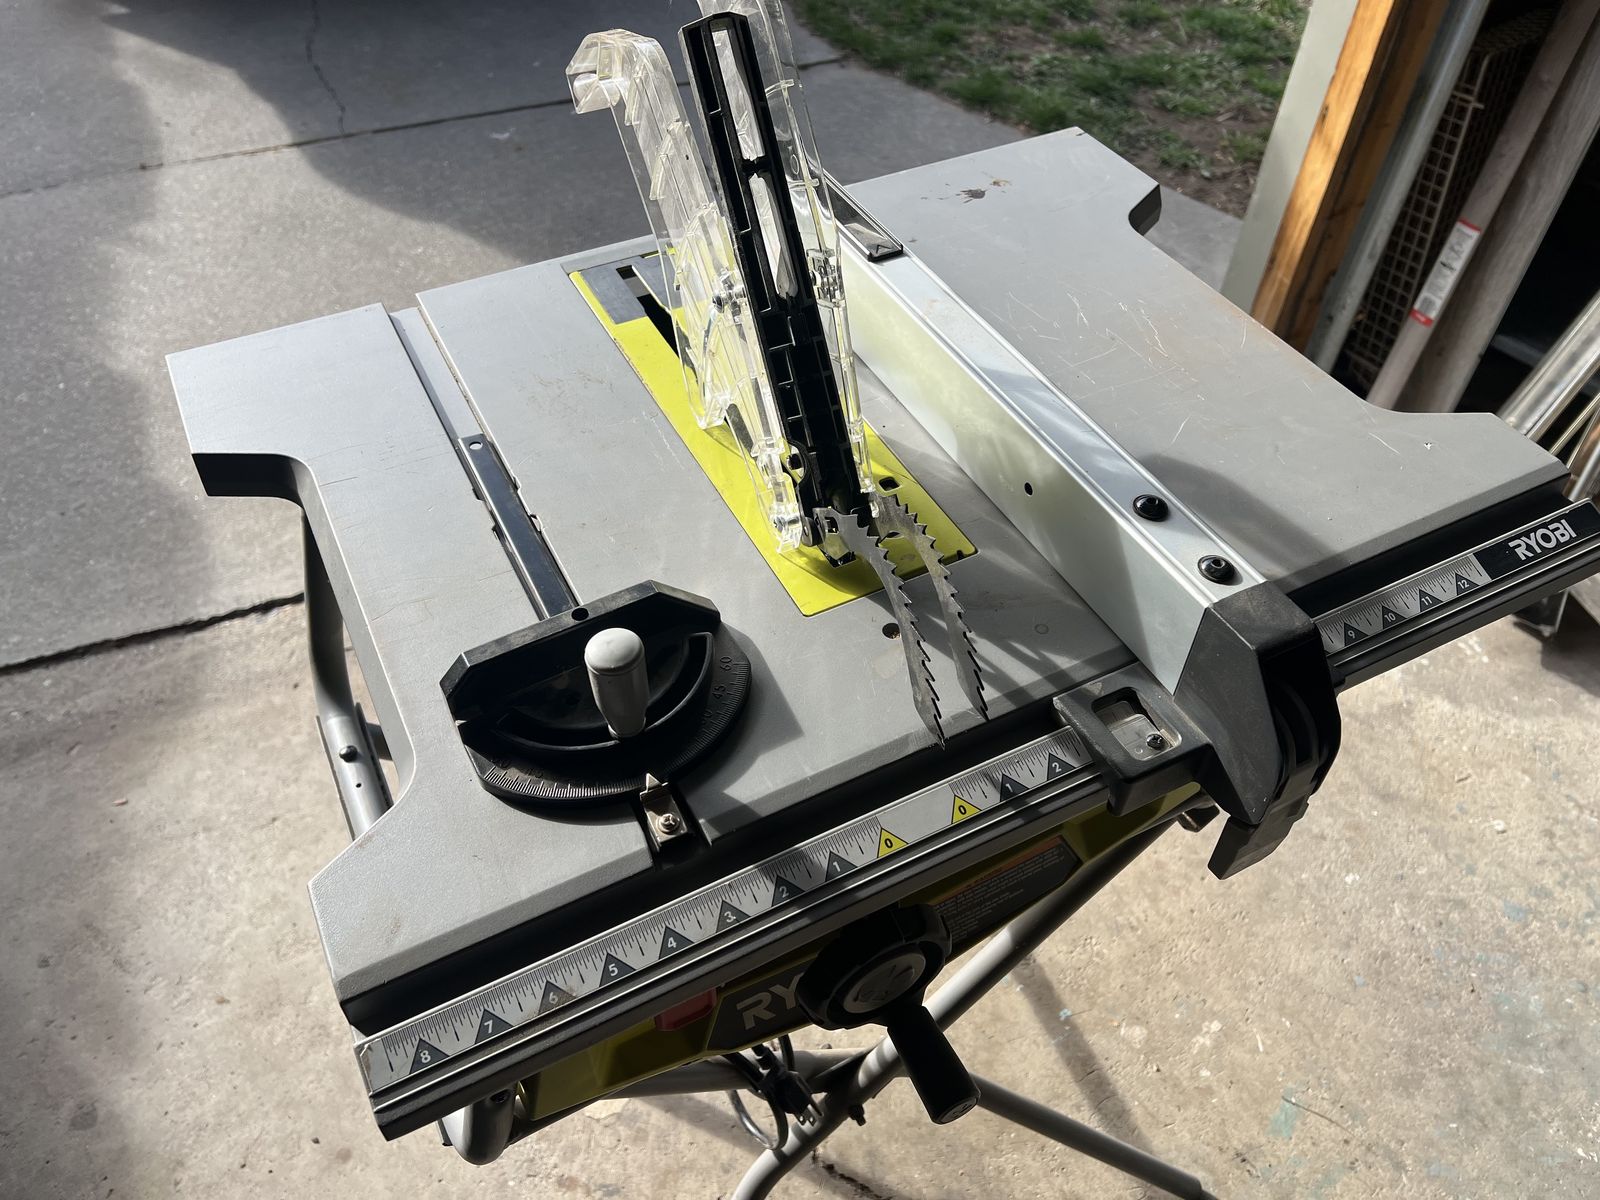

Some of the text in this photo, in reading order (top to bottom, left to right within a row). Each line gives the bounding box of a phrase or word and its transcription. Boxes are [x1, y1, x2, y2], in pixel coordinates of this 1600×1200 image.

[1508, 518, 1578, 561] RYOBI
[1347, 578, 1470, 639] 9 10 11 12
[958, 761, 1062, 816] 0 1 2
[420, 837, 894, 1063] 8 7 6 5 4 3 2 1 0
